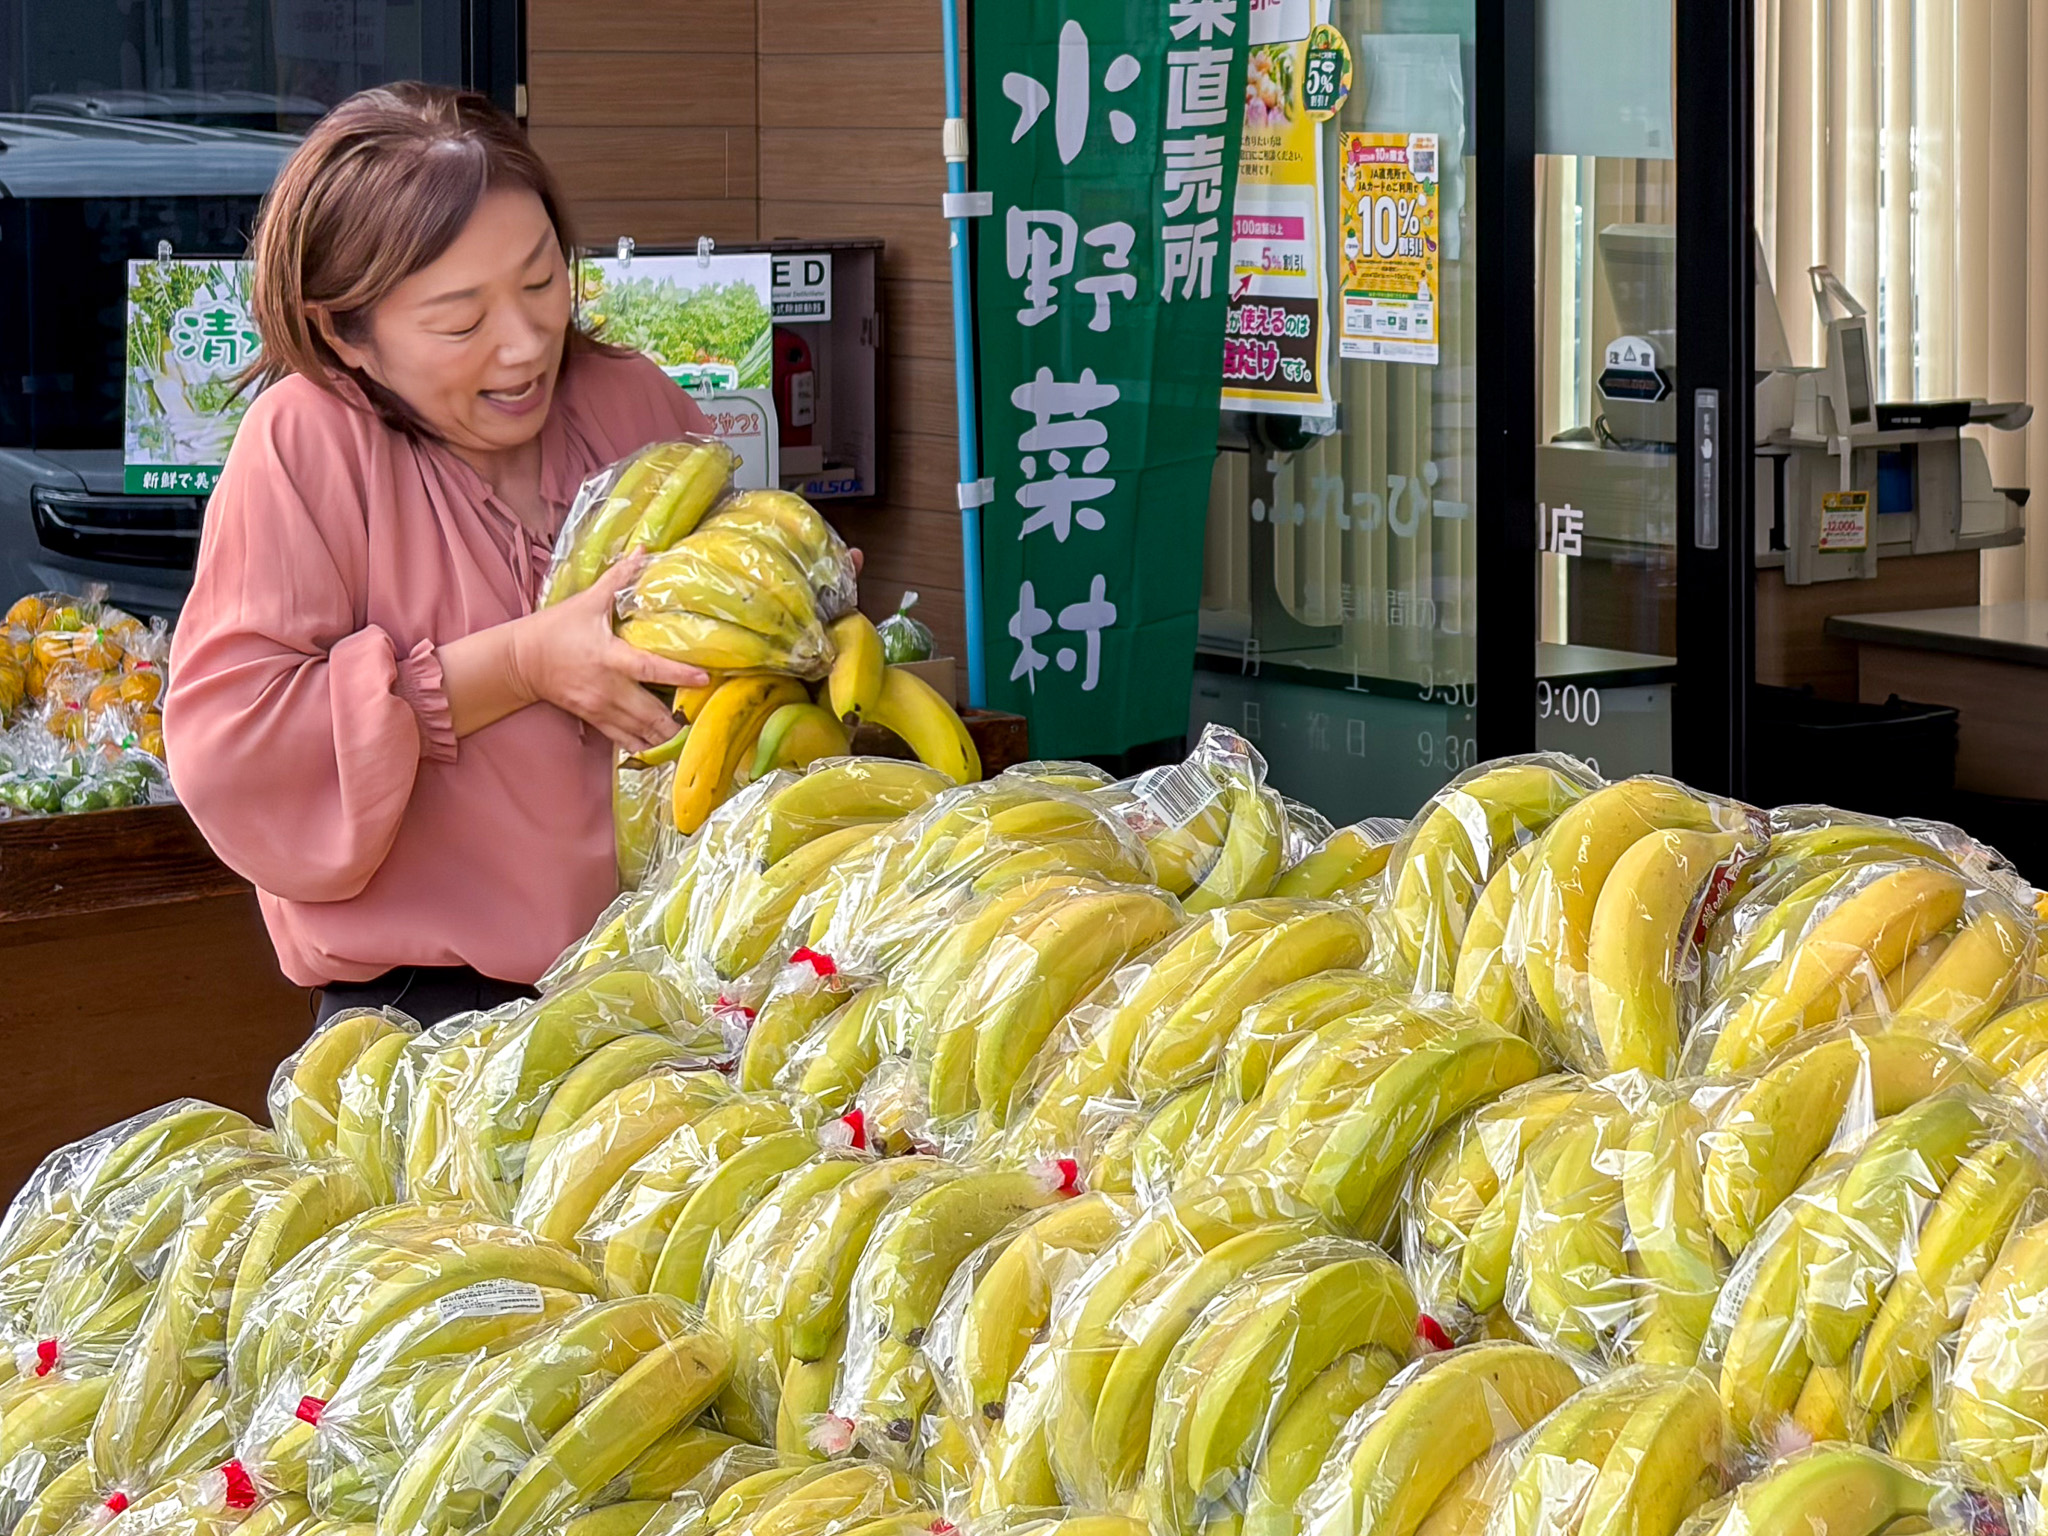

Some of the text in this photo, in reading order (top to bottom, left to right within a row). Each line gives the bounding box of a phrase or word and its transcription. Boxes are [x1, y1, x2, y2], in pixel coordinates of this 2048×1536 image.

[1306, 60, 1334, 94] 5%
[1358, 195, 1420, 259] 10%
[1226, 304, 1310, 338] が使えるのは
[1002, 19, 1141, 696] 水野菜村
